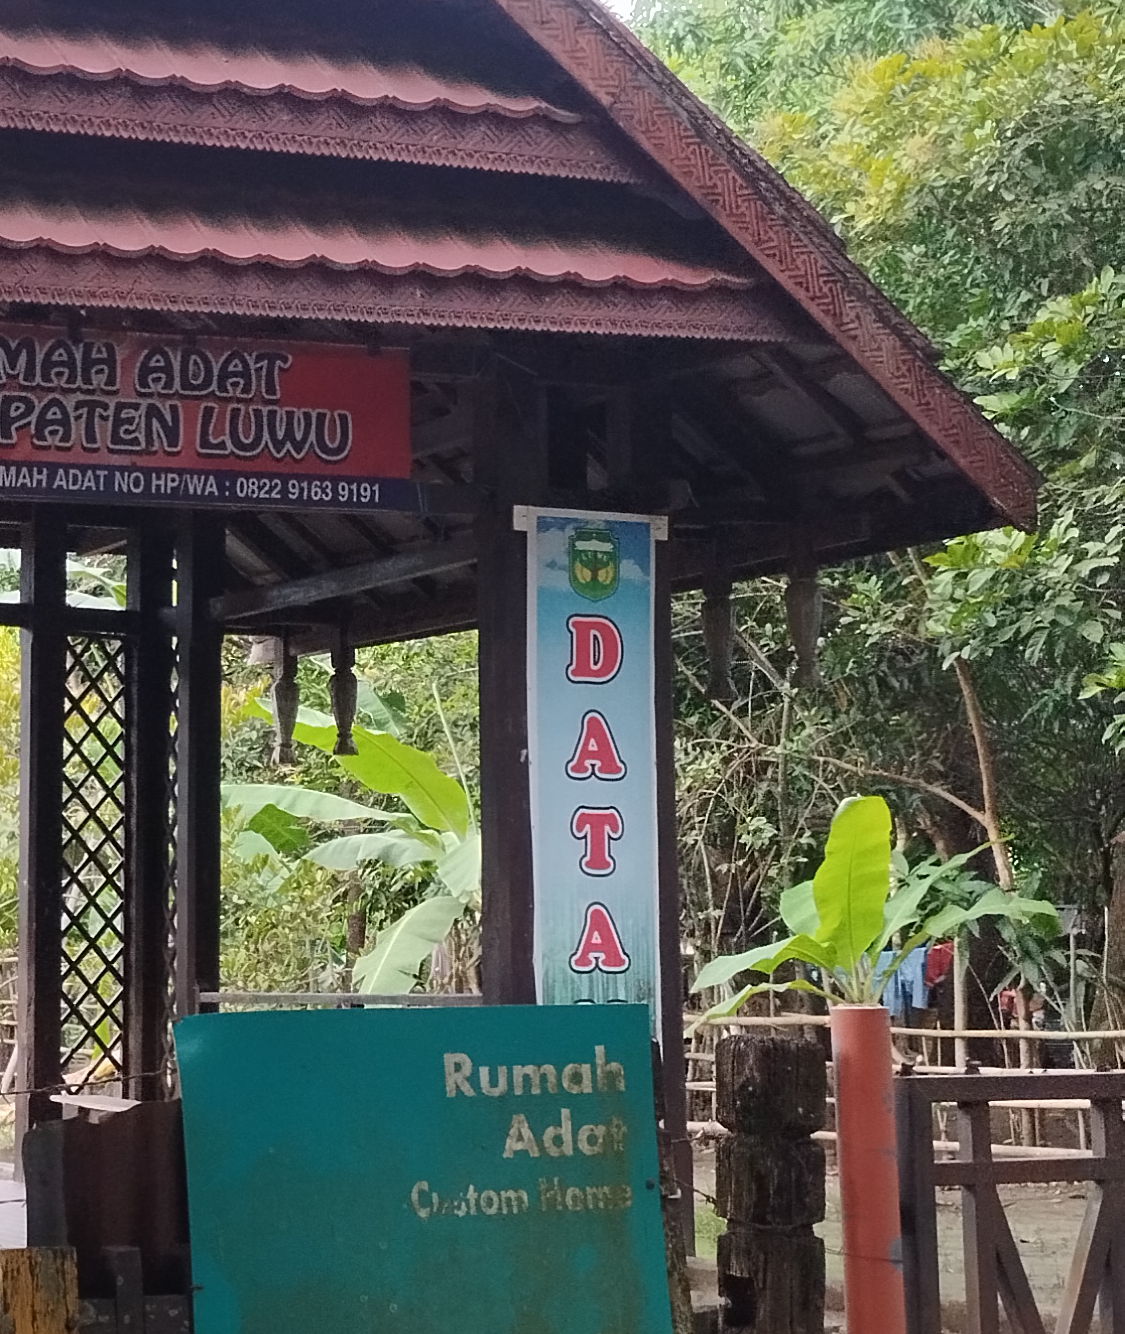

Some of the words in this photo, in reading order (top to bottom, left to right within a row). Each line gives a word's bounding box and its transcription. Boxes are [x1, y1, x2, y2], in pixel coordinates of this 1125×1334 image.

[134, 347, 293, 399] ADAT
[197, 404, 353, 461] LUWU
[53, 468, 110, 493] ADAT
[114, 471, 145, 495] NO
[152, 472, 220, 497] HP/WA
[236, 476, 283, 499] 0822
[288, 478, 334, 501] 9163
[339, 480, 381, 503] 9191
[565, 613, 630, 1004] DATA
[444, 1045, 627, 1098] Rumah
[502, 1107, 627, 1159] Adat
